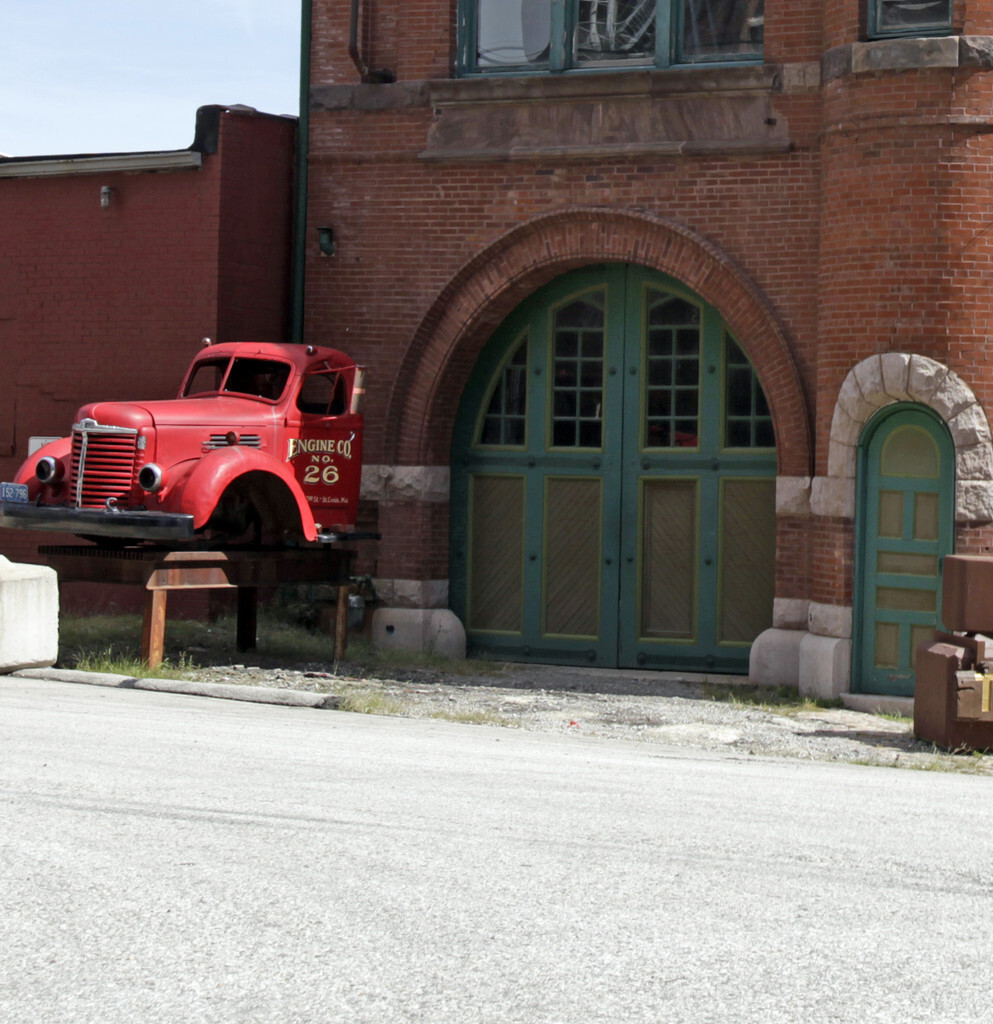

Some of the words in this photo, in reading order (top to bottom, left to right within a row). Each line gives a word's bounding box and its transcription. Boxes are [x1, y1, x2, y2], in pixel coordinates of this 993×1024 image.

[285, 438, 336, 462] ENGINE
[311, 455, 334, 463] NO.
[304, 464, 340, 485] 26
